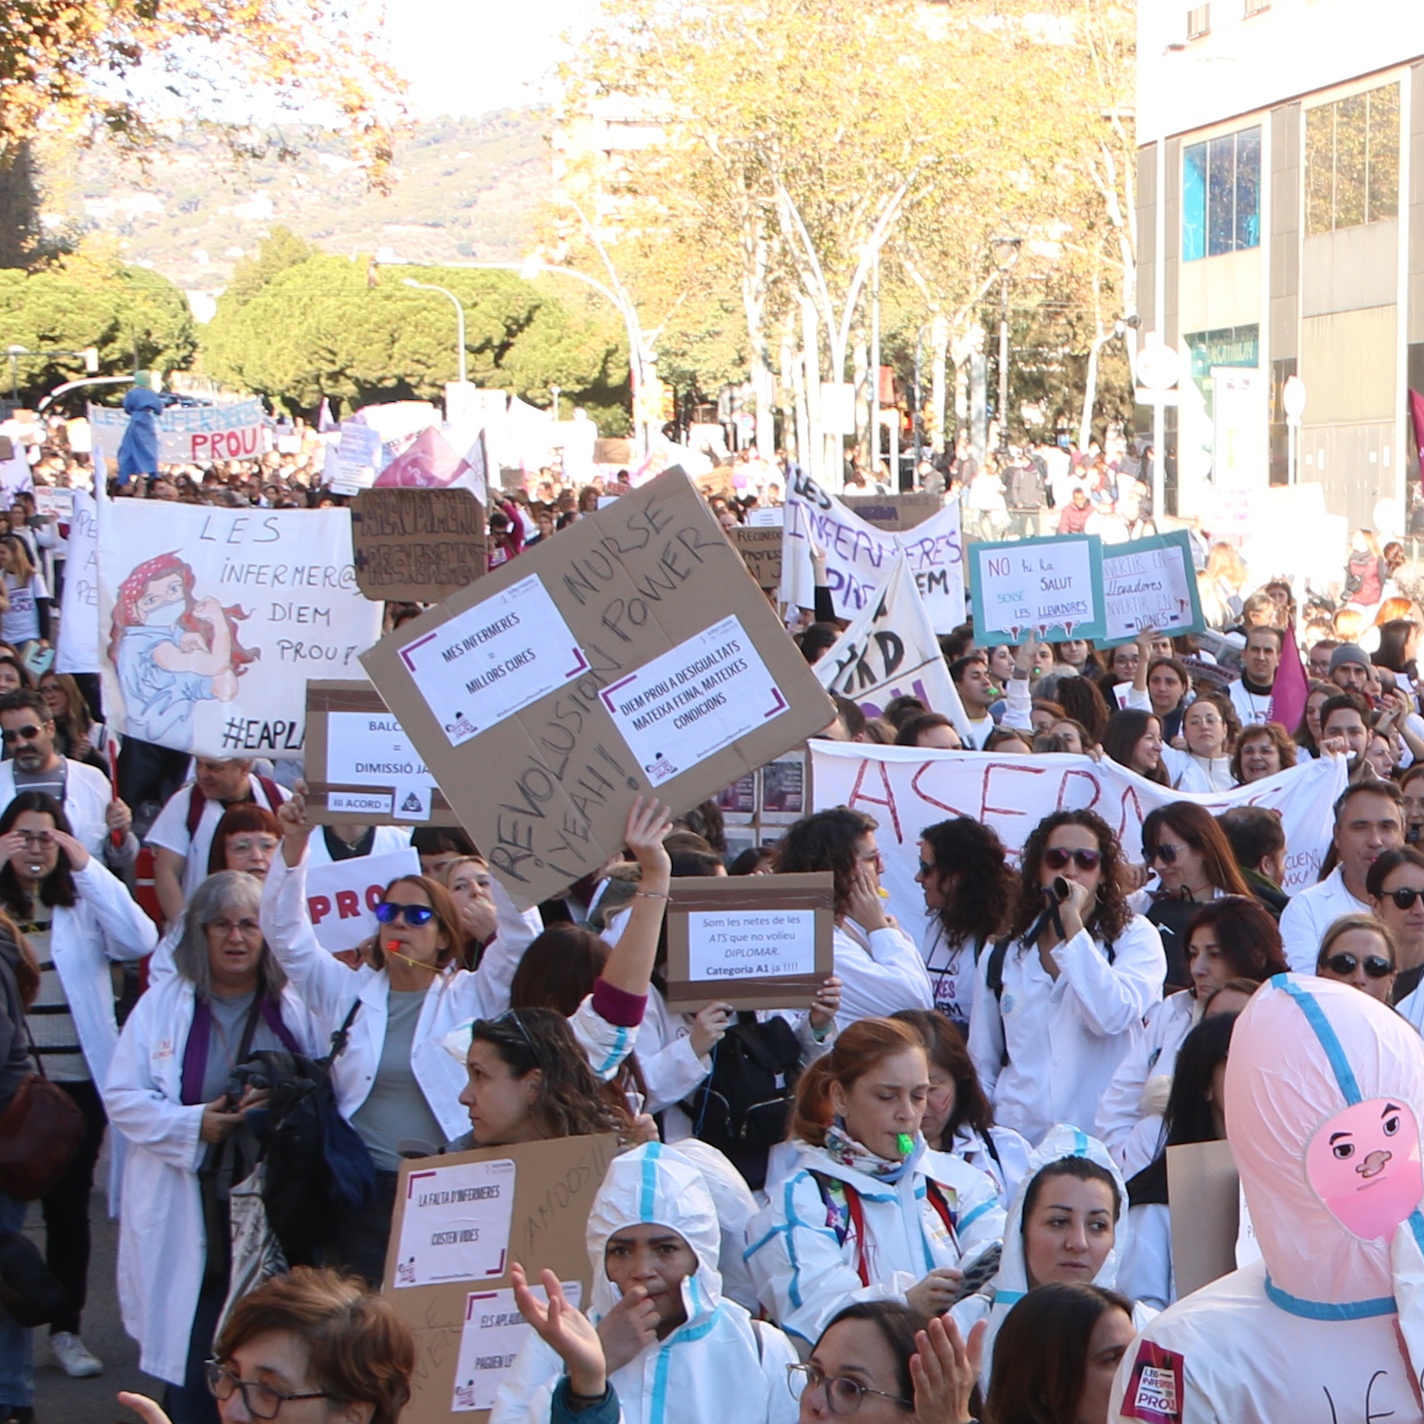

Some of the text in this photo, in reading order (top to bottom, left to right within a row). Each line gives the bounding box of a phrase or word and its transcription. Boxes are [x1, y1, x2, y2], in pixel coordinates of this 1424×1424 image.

[794, 473, 833, 510] LES
[200, 515, 281, 544] LES
[562, 501, 674, 605] NURSE
[987, 557, 1011, 577] NO
[603, 526, 726, 643] POWER
[1040, 576, 1073, 592] SALUT
[998, 591, 1026, 603] SENSE
[1014, 600, 1089, 619] LES LLEVADORES
[441, 612, 521, 666] MÉS INFERMERES
[279, 639, 359, 665] PROU!
[465, 647, 537, 695] MILLORS CURES
[620, 640, 742, 718] DIEM PROU A DESIGUALTATS
[631, 703, 674, 732] MATEIXA
[701, 658, 749, 693] MATEIXES
[673, 691, 728, 731] CONDICIONS
[355, 761, 413, 774] DIMISSIÓ
[345, 799, 382, 809] ACORD
[703, 914, 802, 928] Som les netes de les
[708, 933, 761, 946] ATS que no
[706, 963, 781, 978] Categoria A1 ja
[418, 1184, 501, 1208] LA FALTA D'INFERMERES
[431, 1227, 480, 1246] COSTEN VIDES
[480, 1313, 494, 1329] ELS
[474, 1353, 503, 1371] PAGUEN
